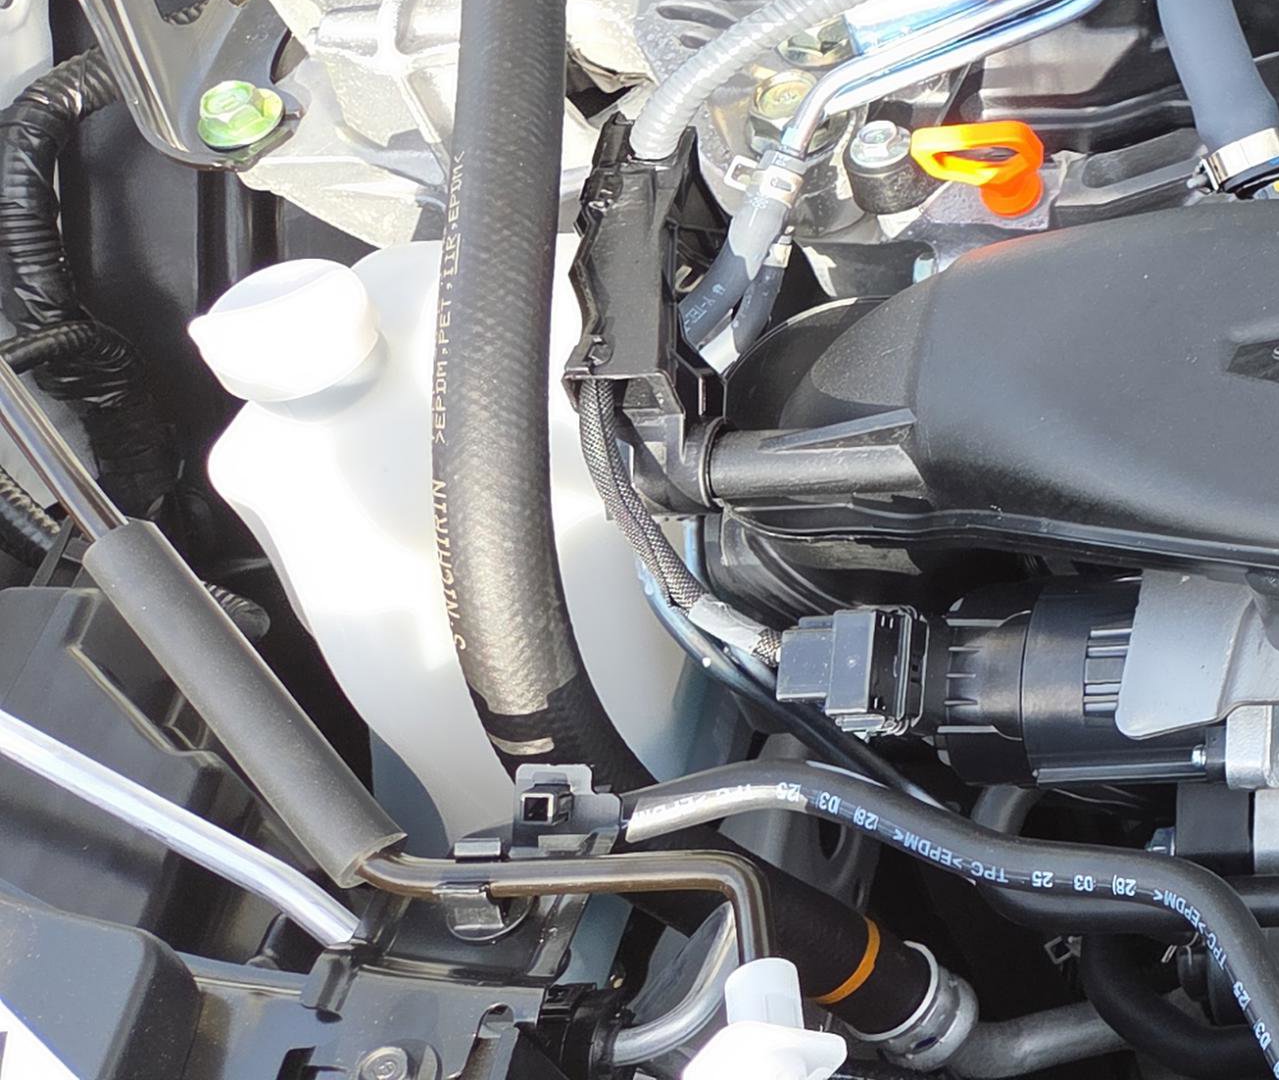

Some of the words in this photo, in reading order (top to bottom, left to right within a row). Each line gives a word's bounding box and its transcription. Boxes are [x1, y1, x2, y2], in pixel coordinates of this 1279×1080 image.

[891, 827, 964, 869] >EPDM<
[970, 859, 1009, 884] TPC
[1031, 870, 1054, 888] 25
[1073, 874, 1095, 892] 03
